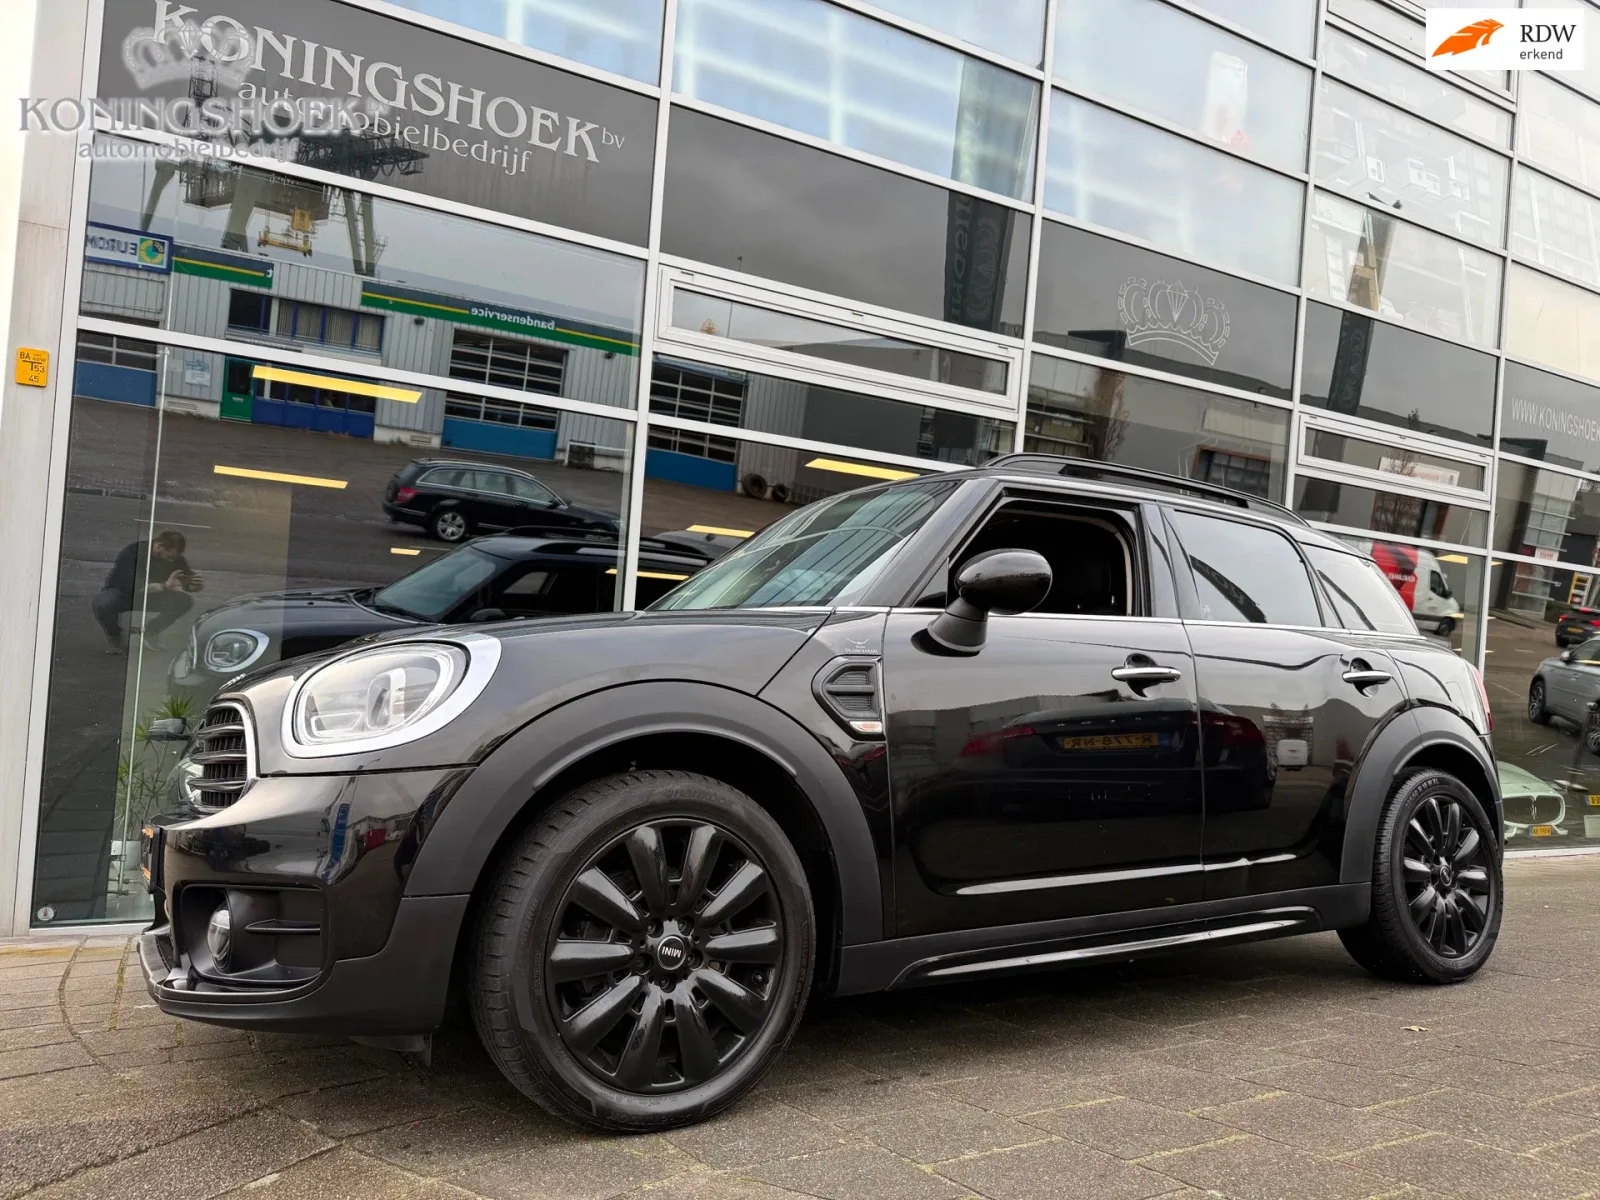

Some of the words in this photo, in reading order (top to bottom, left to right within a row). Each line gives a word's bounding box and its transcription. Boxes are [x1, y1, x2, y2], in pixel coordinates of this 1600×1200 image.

[153, 0, 600, 163] KONINGSHOEK
[602, 126, 625, 149] bv
[19, 351, 31, 360] BA
[661, 945, 682, 959] MINI
